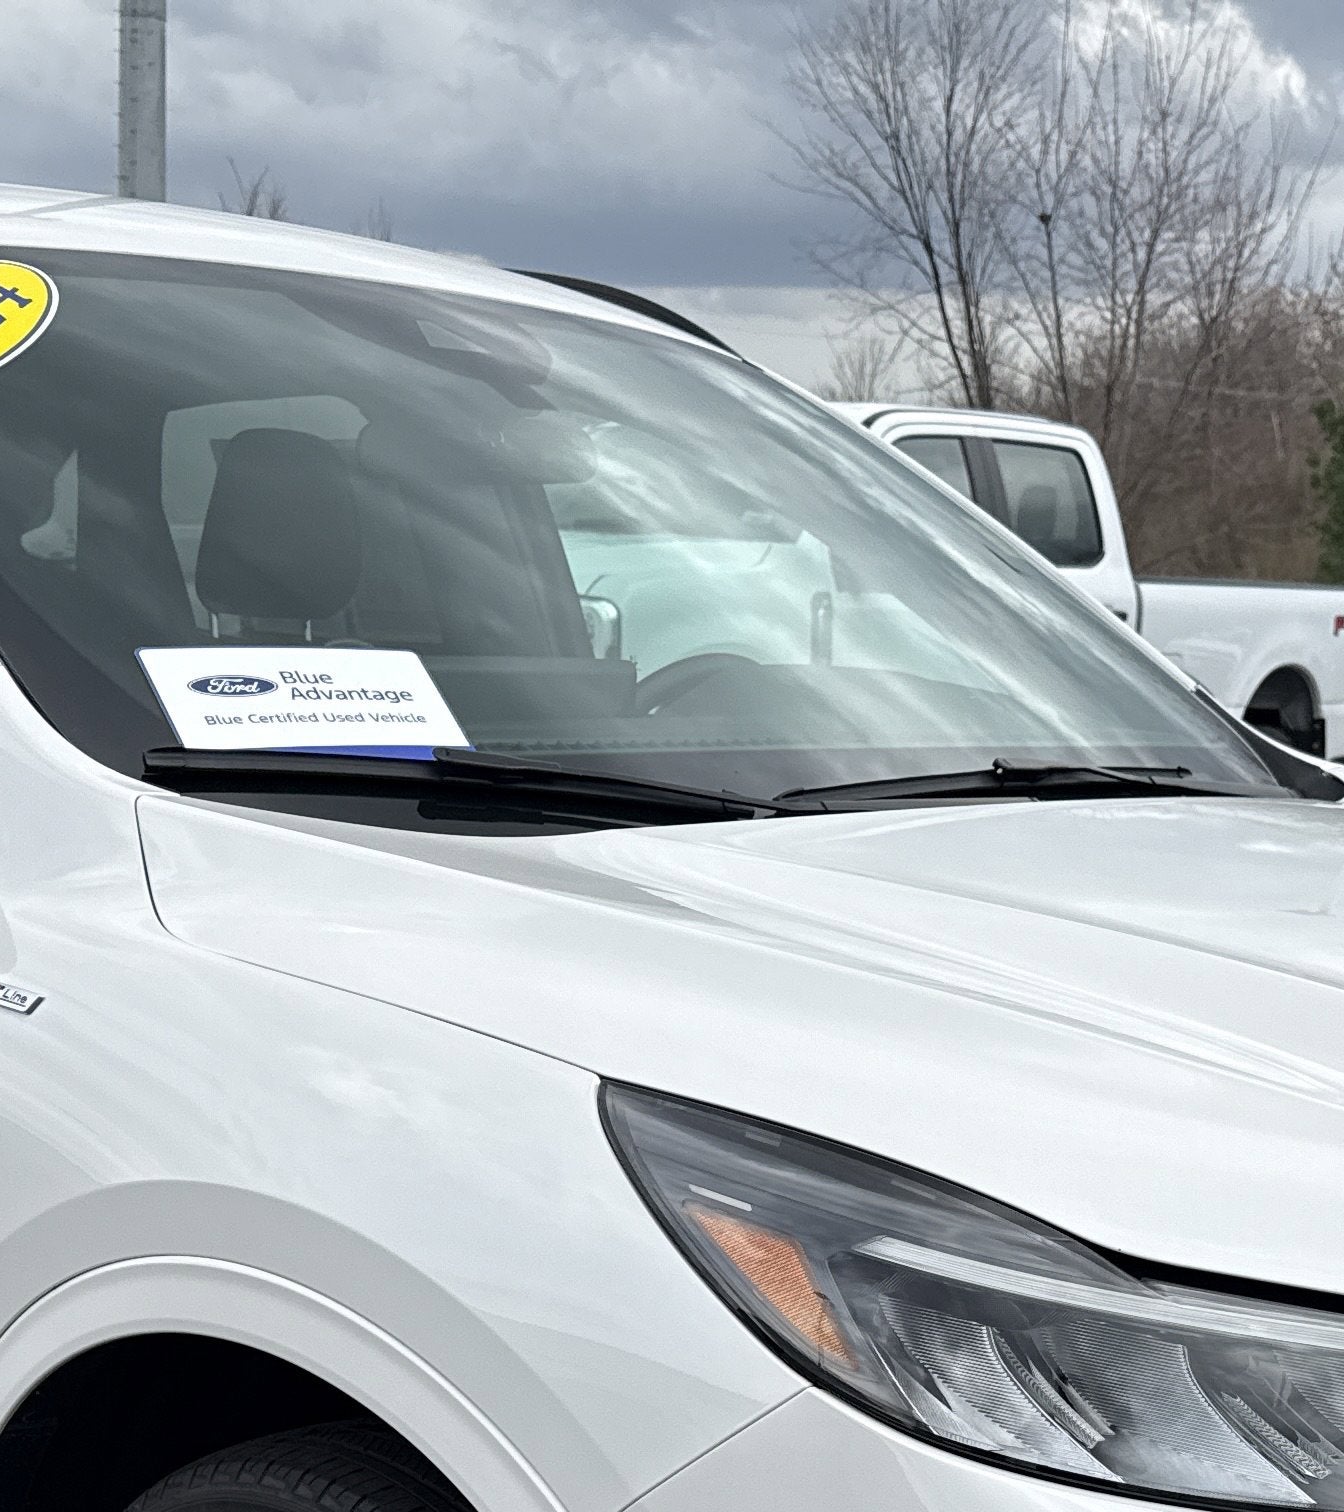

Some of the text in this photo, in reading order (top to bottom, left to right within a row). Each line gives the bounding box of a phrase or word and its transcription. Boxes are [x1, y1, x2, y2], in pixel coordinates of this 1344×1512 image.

[279, 670, 333, 685] Blue
[206, 677, 261, 695] Ford
[291, 686, 414, 704] Advantage
[204, 711, 427, 726] Blue Certified Used Vehicle
